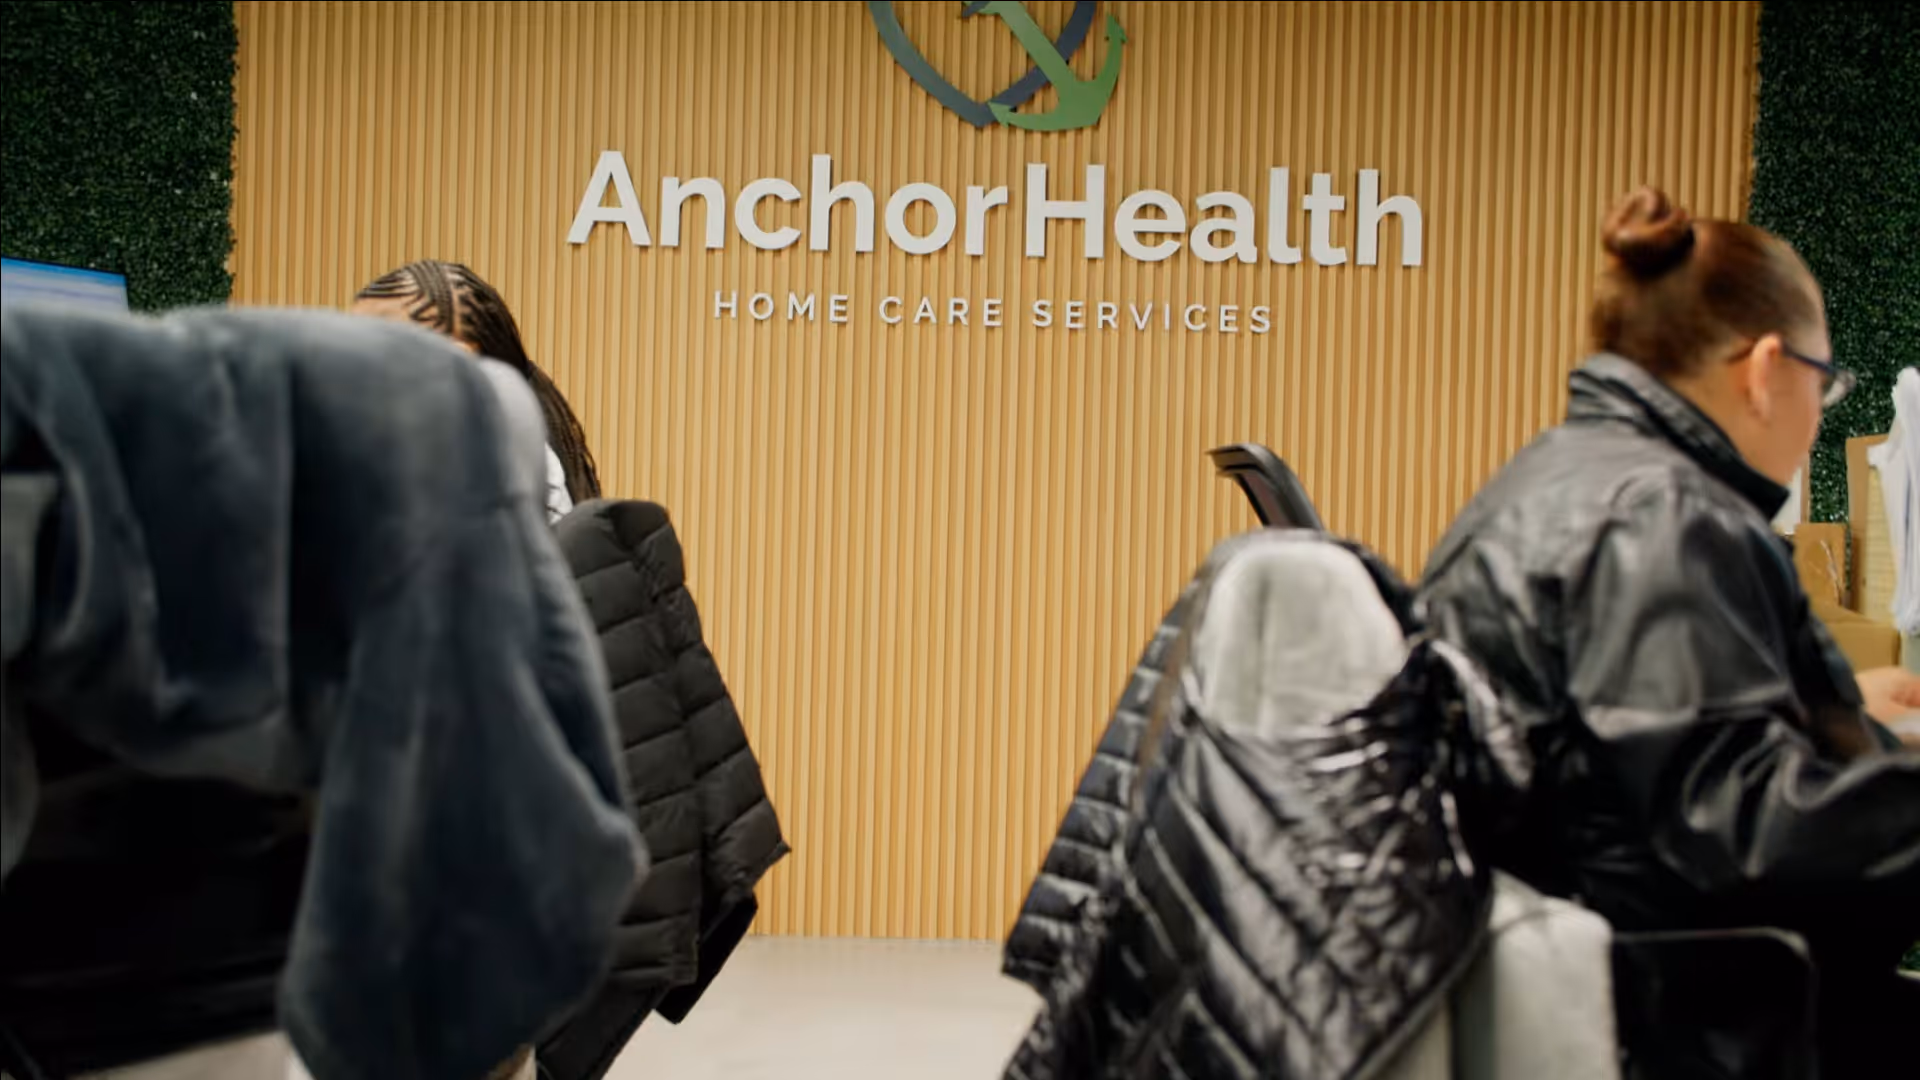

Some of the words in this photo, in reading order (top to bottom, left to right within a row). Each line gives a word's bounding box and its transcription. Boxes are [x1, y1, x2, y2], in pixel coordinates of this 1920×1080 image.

[714, 291, 849, 323] HOME
[879, 296, 1002, 328] CARE
[1032, 300, 1272, 333] SERVICES
